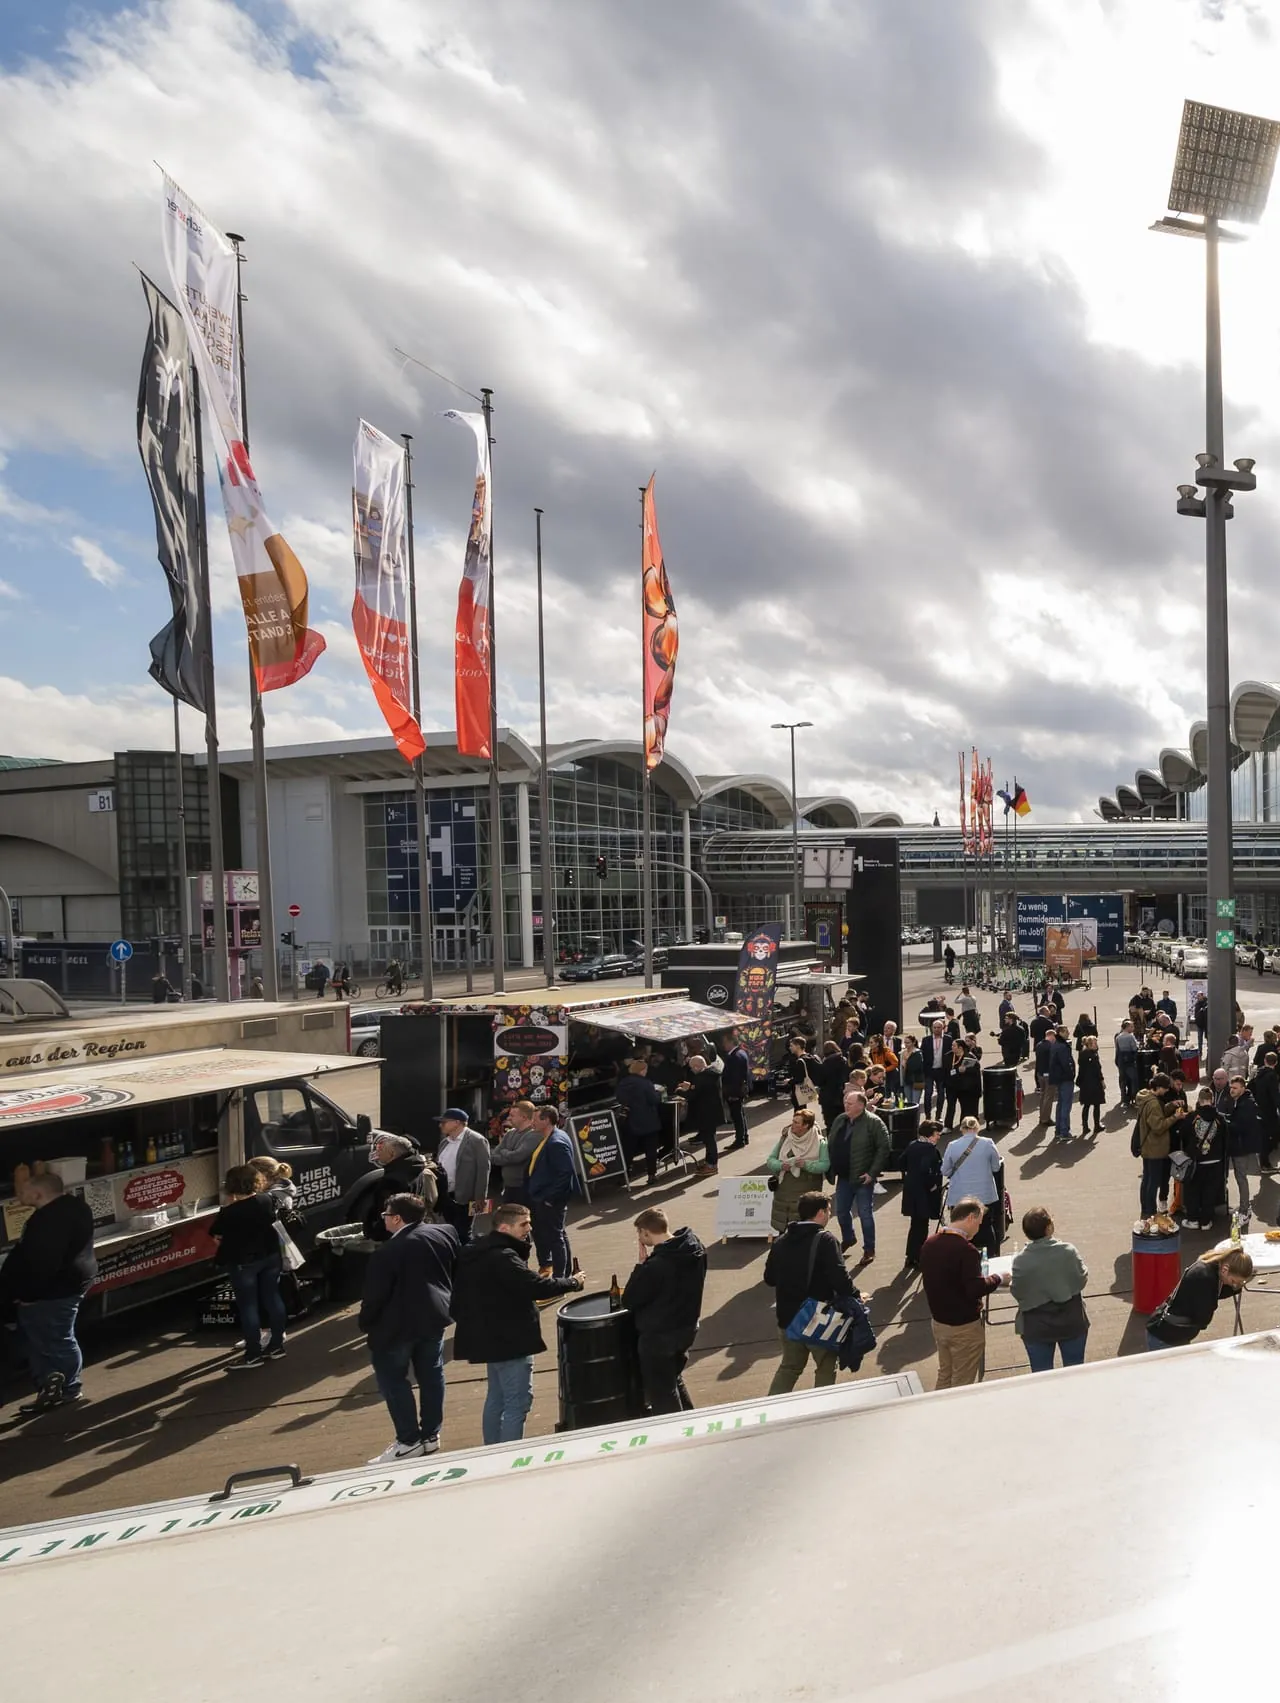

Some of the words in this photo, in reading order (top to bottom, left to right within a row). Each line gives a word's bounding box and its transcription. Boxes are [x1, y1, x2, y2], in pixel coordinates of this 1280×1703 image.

[1018, 902, 1027, 911] Zu
[6, 1053, 45, 1068] aus
[47, 1046, 80, 1062] der
[82, 1038, 147, 1058] Region
[300, 1166, 331, 1183] HIER
[295, 1175, 337, 1197] ESSEN
[599, 1434, 649, 1452] US
